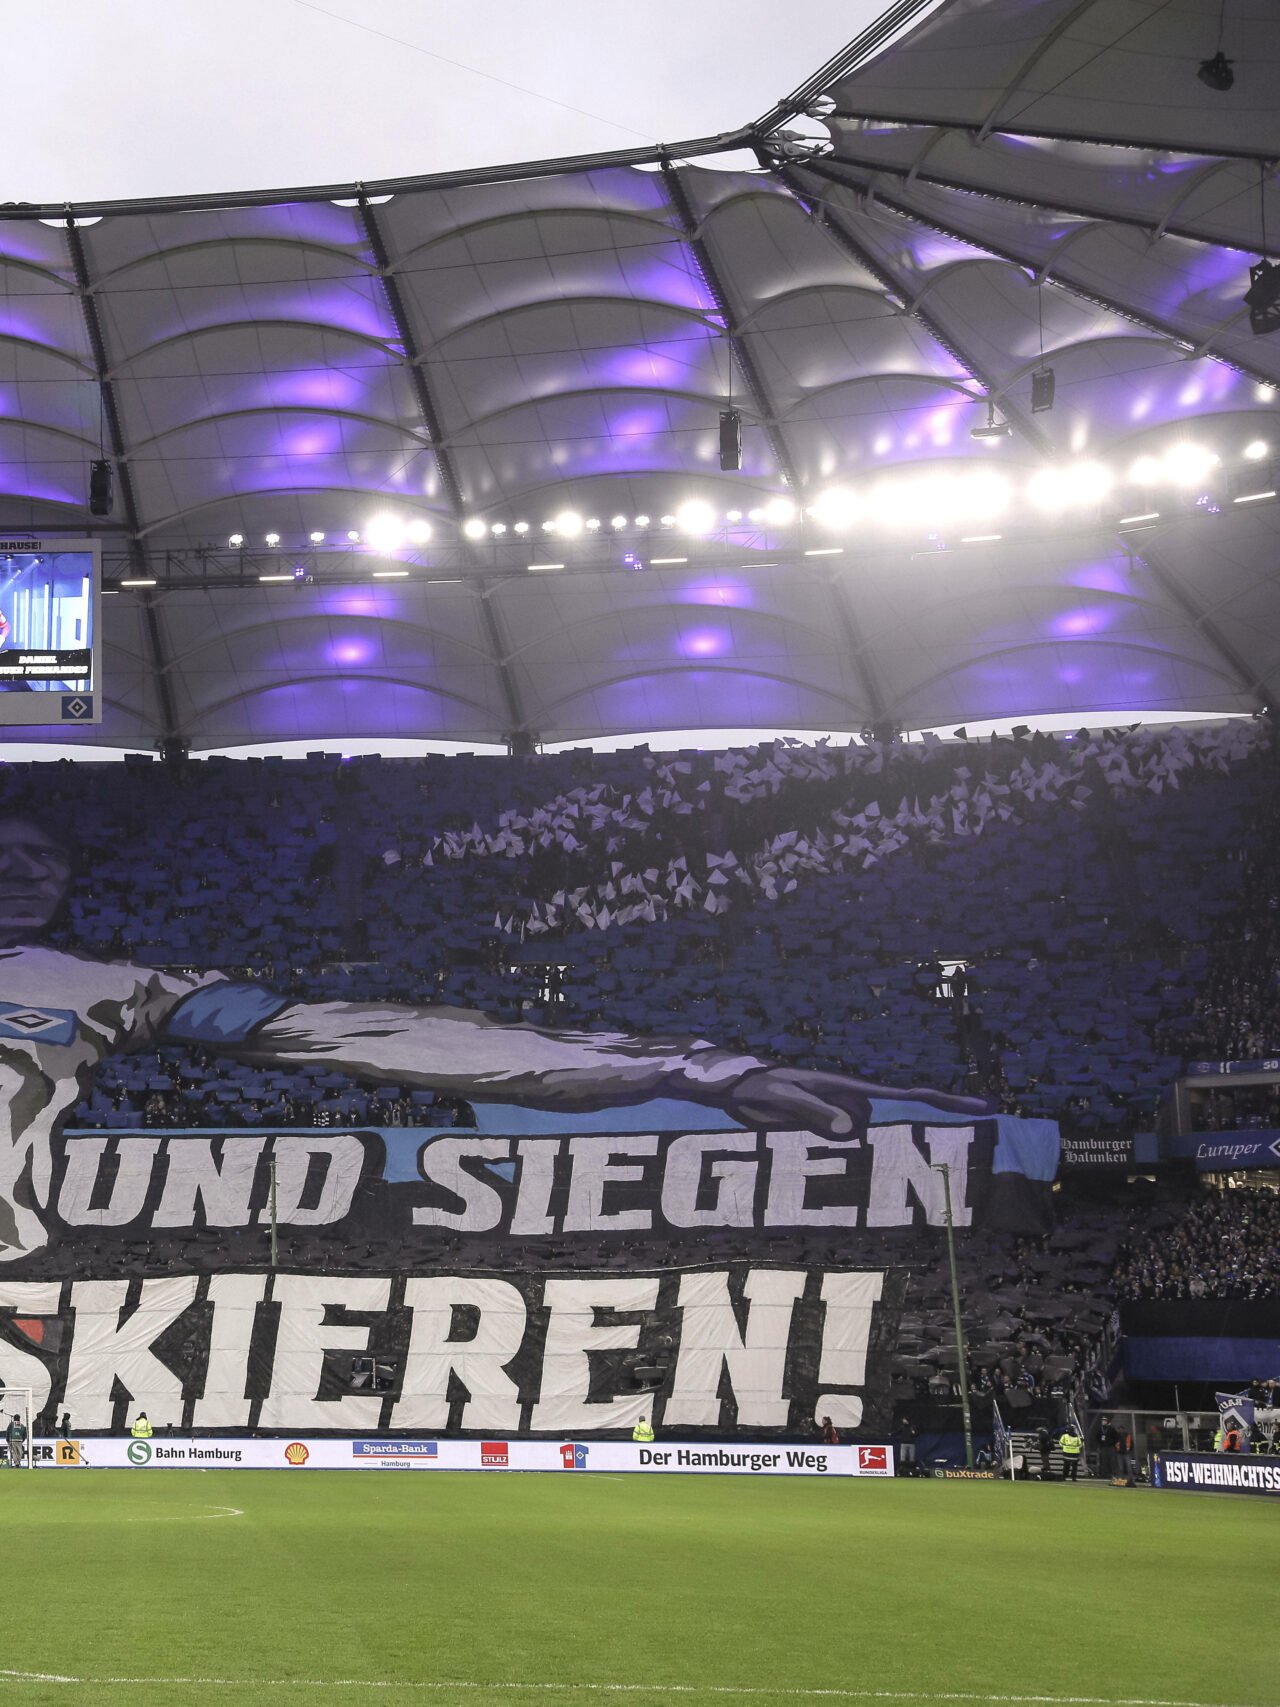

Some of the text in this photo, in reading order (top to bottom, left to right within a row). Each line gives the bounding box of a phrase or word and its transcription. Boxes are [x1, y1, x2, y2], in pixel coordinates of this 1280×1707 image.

[1064, 1151, 1128, 1165] Halunken
[1196, 1142, 1263, 1161] Luruper
[57, 1135, 365, 1228] UND
[412, 1124, 975, 1235] SIEGEN
[156, 1447, 185, 1459] Bahn
[189, 1447, 242, 1462] Hamburg
[363, 1443, 428, 1454] Sparda-Bank
[639, 1448, 828, 1472] Der Hamburger Weg
[945, 1469, 995, 1479] buXtrade
